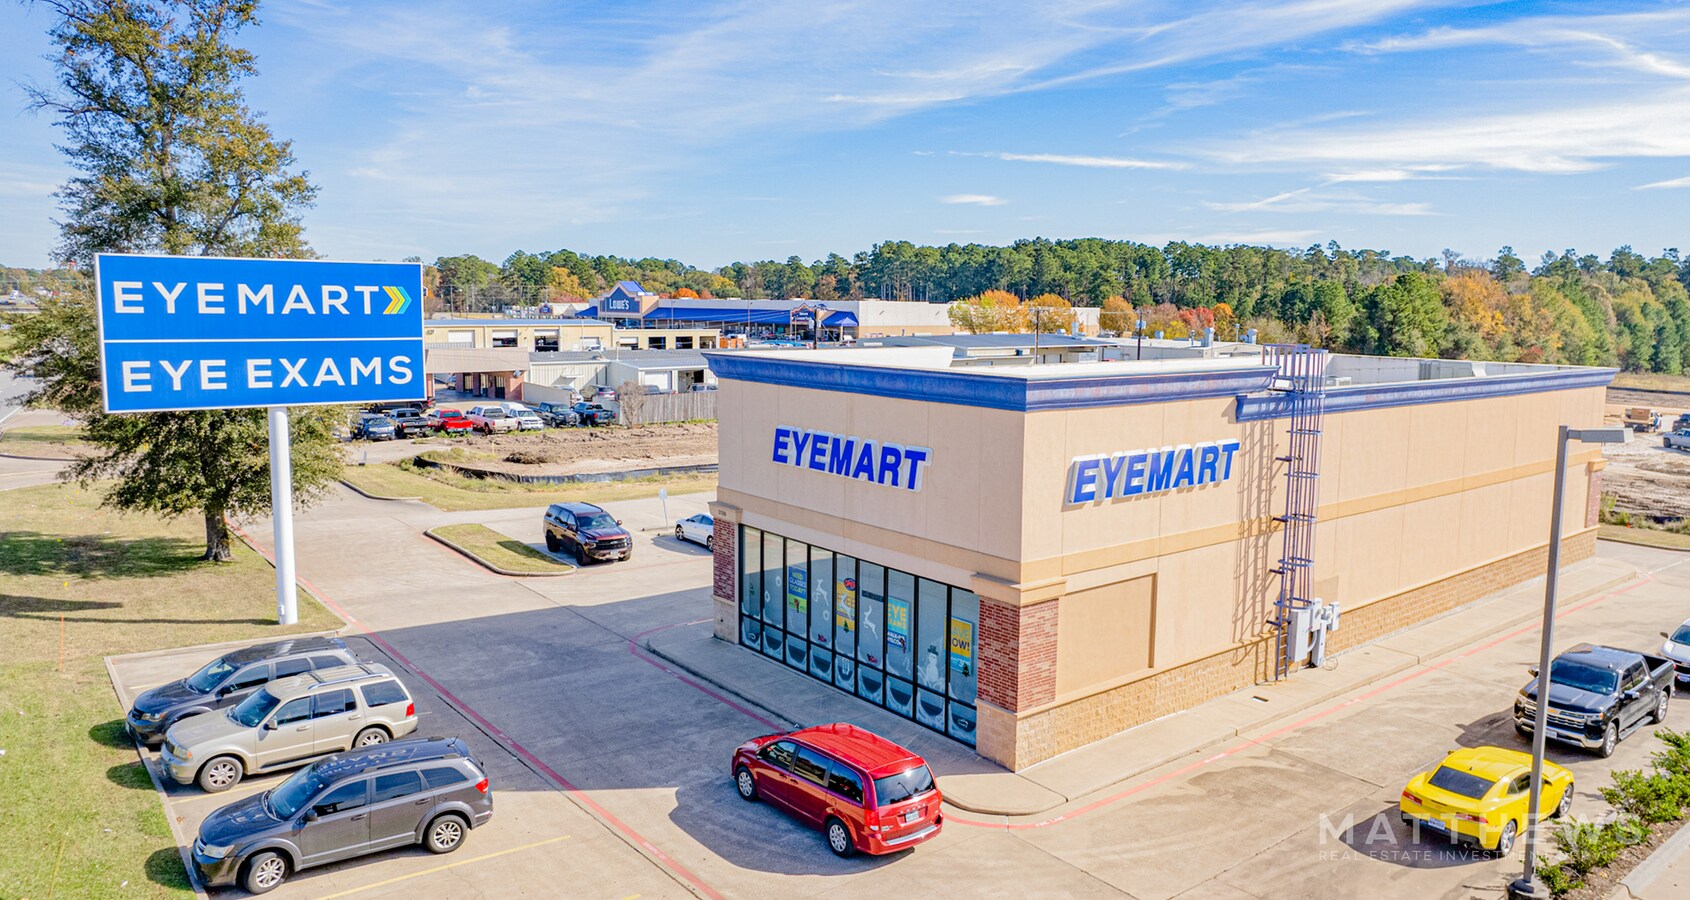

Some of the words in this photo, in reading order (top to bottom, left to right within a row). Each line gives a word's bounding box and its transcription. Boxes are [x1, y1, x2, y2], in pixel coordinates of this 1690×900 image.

[112, 281, 379, 315] EYEMART
[122, 359, 227, 392] EYE
[247, 355, 413, 388] EXAMS
[772, 427, 929, 491] EYEMART
[1070, 441, 1240, 504] EYEMART
[888, 602, 907, 622] EYE
[952, 626, 969, 641] AVE
[952, 637, 970, 651] OW!
